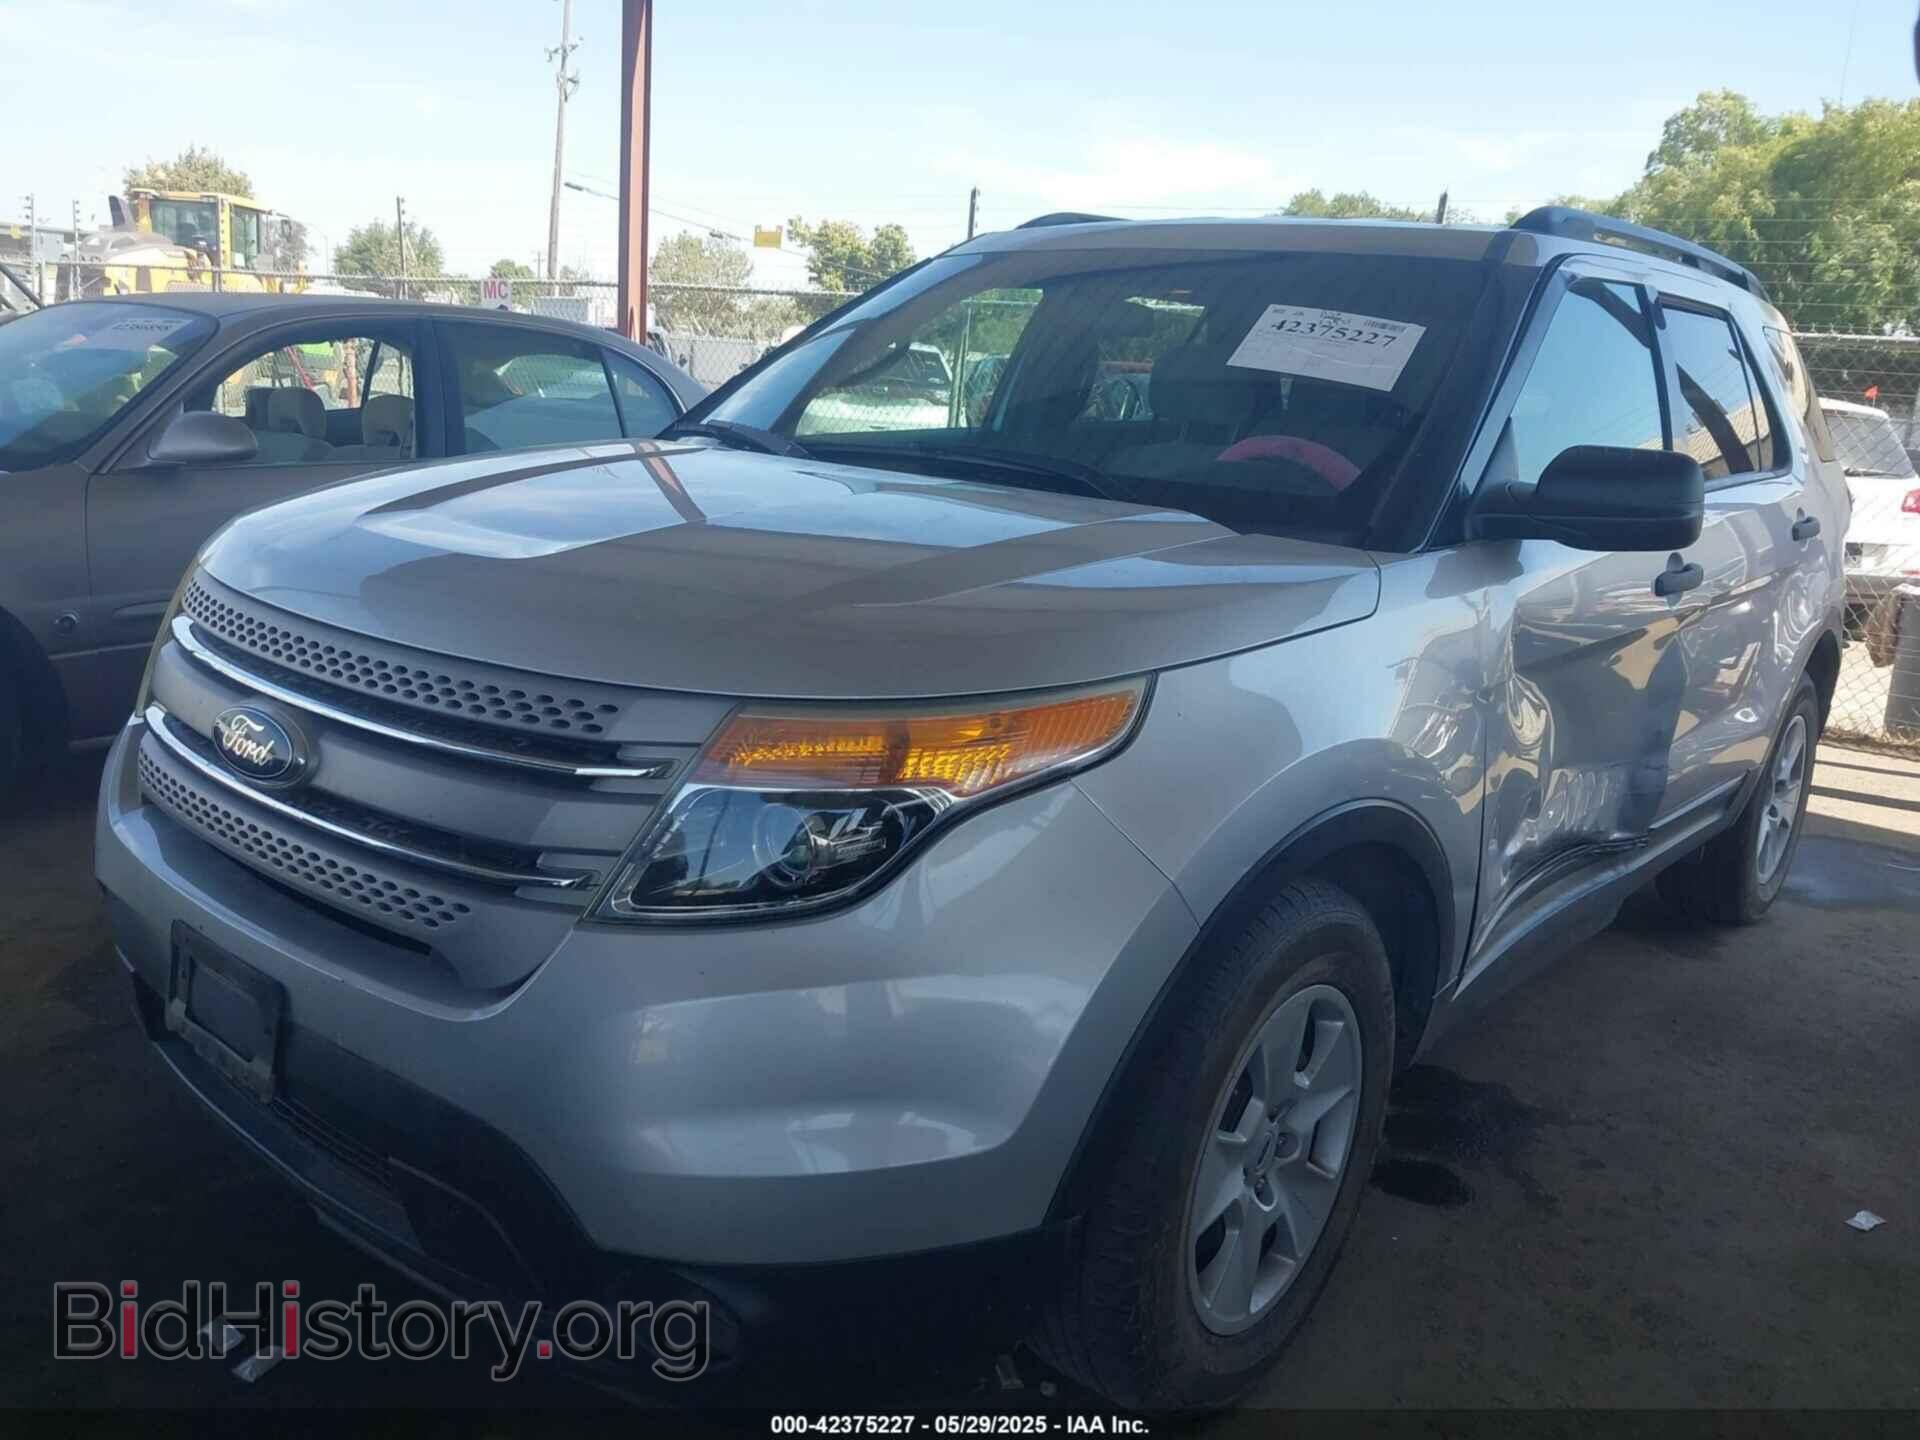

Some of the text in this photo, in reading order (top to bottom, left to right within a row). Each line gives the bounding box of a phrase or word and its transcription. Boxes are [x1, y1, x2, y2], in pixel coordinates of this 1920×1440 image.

[483, 280, 510, 299] MC
[1271, 319, 1398, 348] 42375227
[222, 714, 274, 767] Ford
